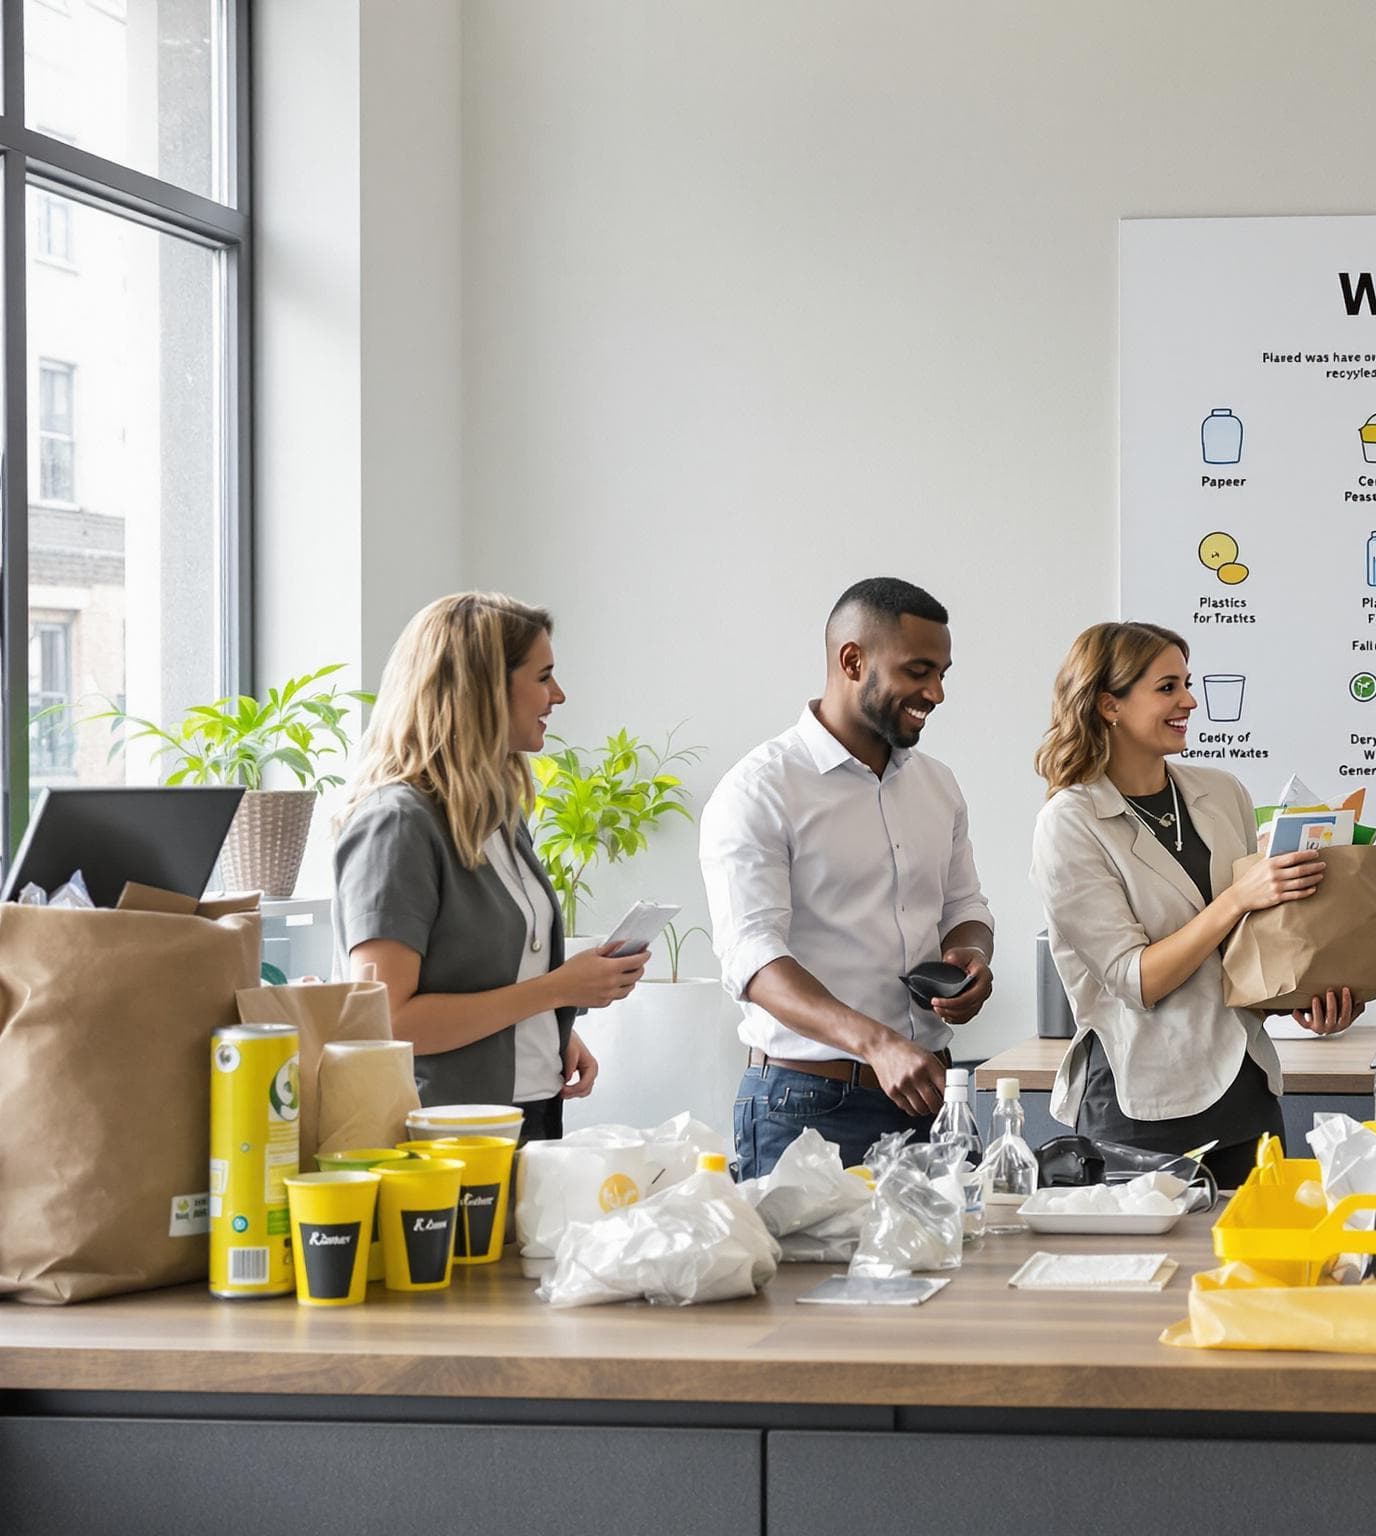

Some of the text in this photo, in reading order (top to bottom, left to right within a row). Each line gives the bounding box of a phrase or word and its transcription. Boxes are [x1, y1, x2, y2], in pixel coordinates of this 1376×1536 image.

[1304, 353, 1330, 363] was
[1201, 475, 1247, 489] Papeer
[1199, 596, 1248, 609] Plastics
[1193, 611, 1212, 624] for
[1237, 731, 1252, 743] of
[1180, 747, 1226, 759] General
